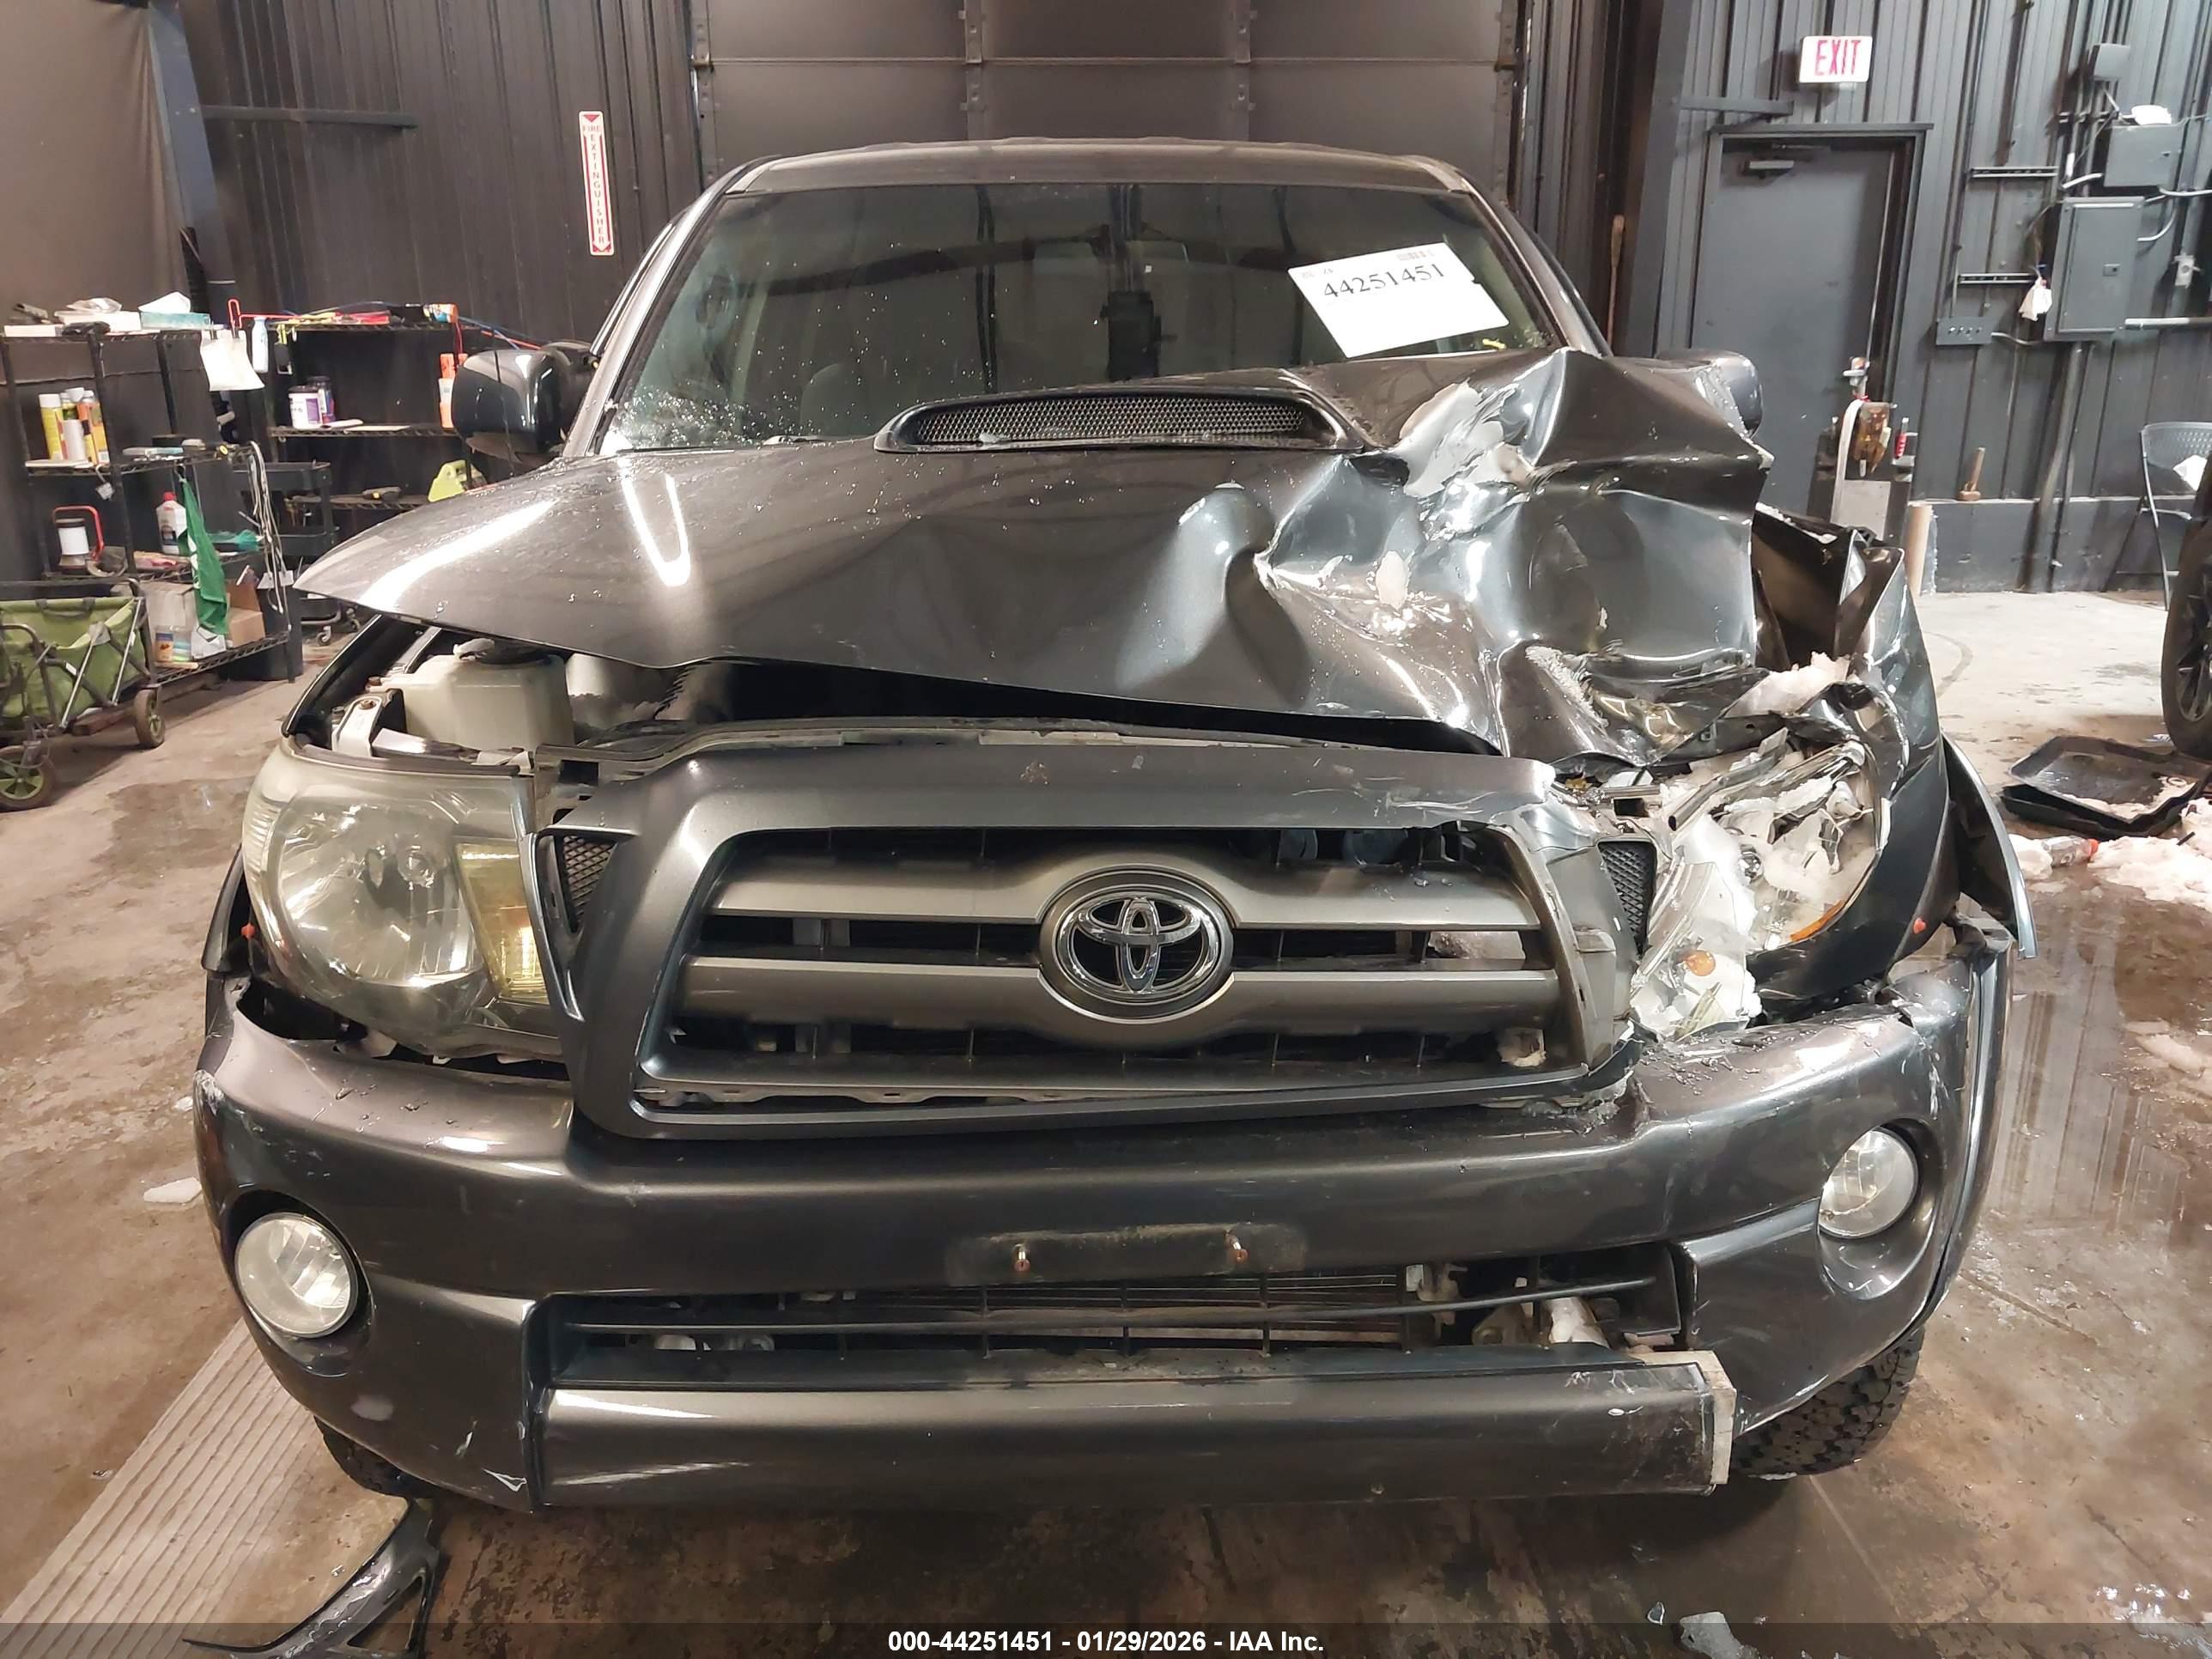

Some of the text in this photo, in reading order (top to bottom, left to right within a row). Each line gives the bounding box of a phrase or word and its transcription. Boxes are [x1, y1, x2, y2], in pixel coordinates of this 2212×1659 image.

[1814, 40, 1862, 76] EXIT
[582, 125, 602, 133] FIRE
[590, 134, 605, 244] EXTINGUISHER
[1324, 263, 1444, 297] 44251451
